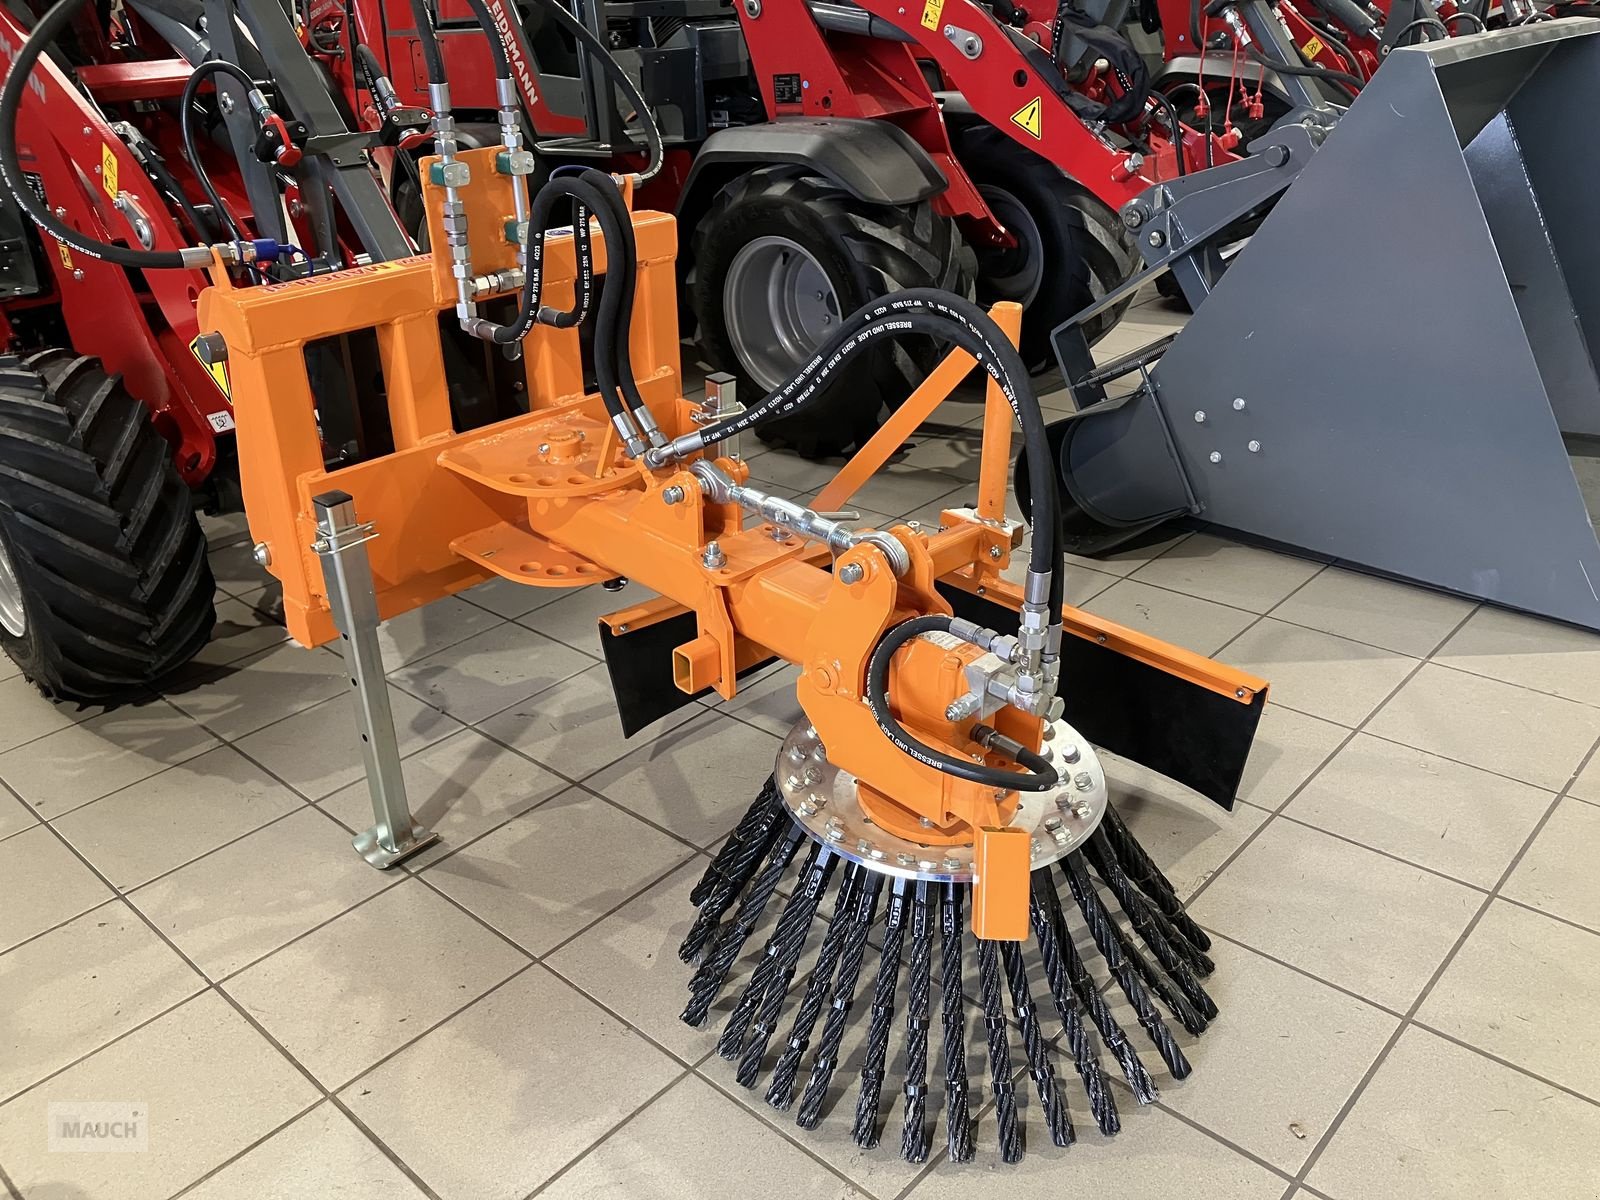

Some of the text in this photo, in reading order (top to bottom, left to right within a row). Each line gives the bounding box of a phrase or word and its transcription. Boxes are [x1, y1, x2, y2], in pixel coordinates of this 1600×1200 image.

[492, 0, 538, 105] EIDEMANN
[48, 229, 64, 242] UND
[65, 239, 101, 258] BRESSEL
[531, 293, 538, 304] WP
[891, 301, 904, 309] BAR
[872, 325, 885, 335] UND
[885, 321, 913, 331] BRESSEL
[857, 331, 873, 343] LADE
[841, 339, 857, 355] HD213
[803, 354, 823, 375] BRESSEL
[986, 362, 1000, 379] 4Q23
[794, 373, 806, 386] UND
[783, 381, 798, 396] LADE
[1002, 384, 1014, 401] BAR
[768, 395, 783, 409] HD213
[703, 435, 711, 443] 27
[711, 431, 722, 440] WP
[880, 724, 896, 741] LADE
[894, 738, 909, 751] UND
[909, 746, 943, 769] BRESSEL
